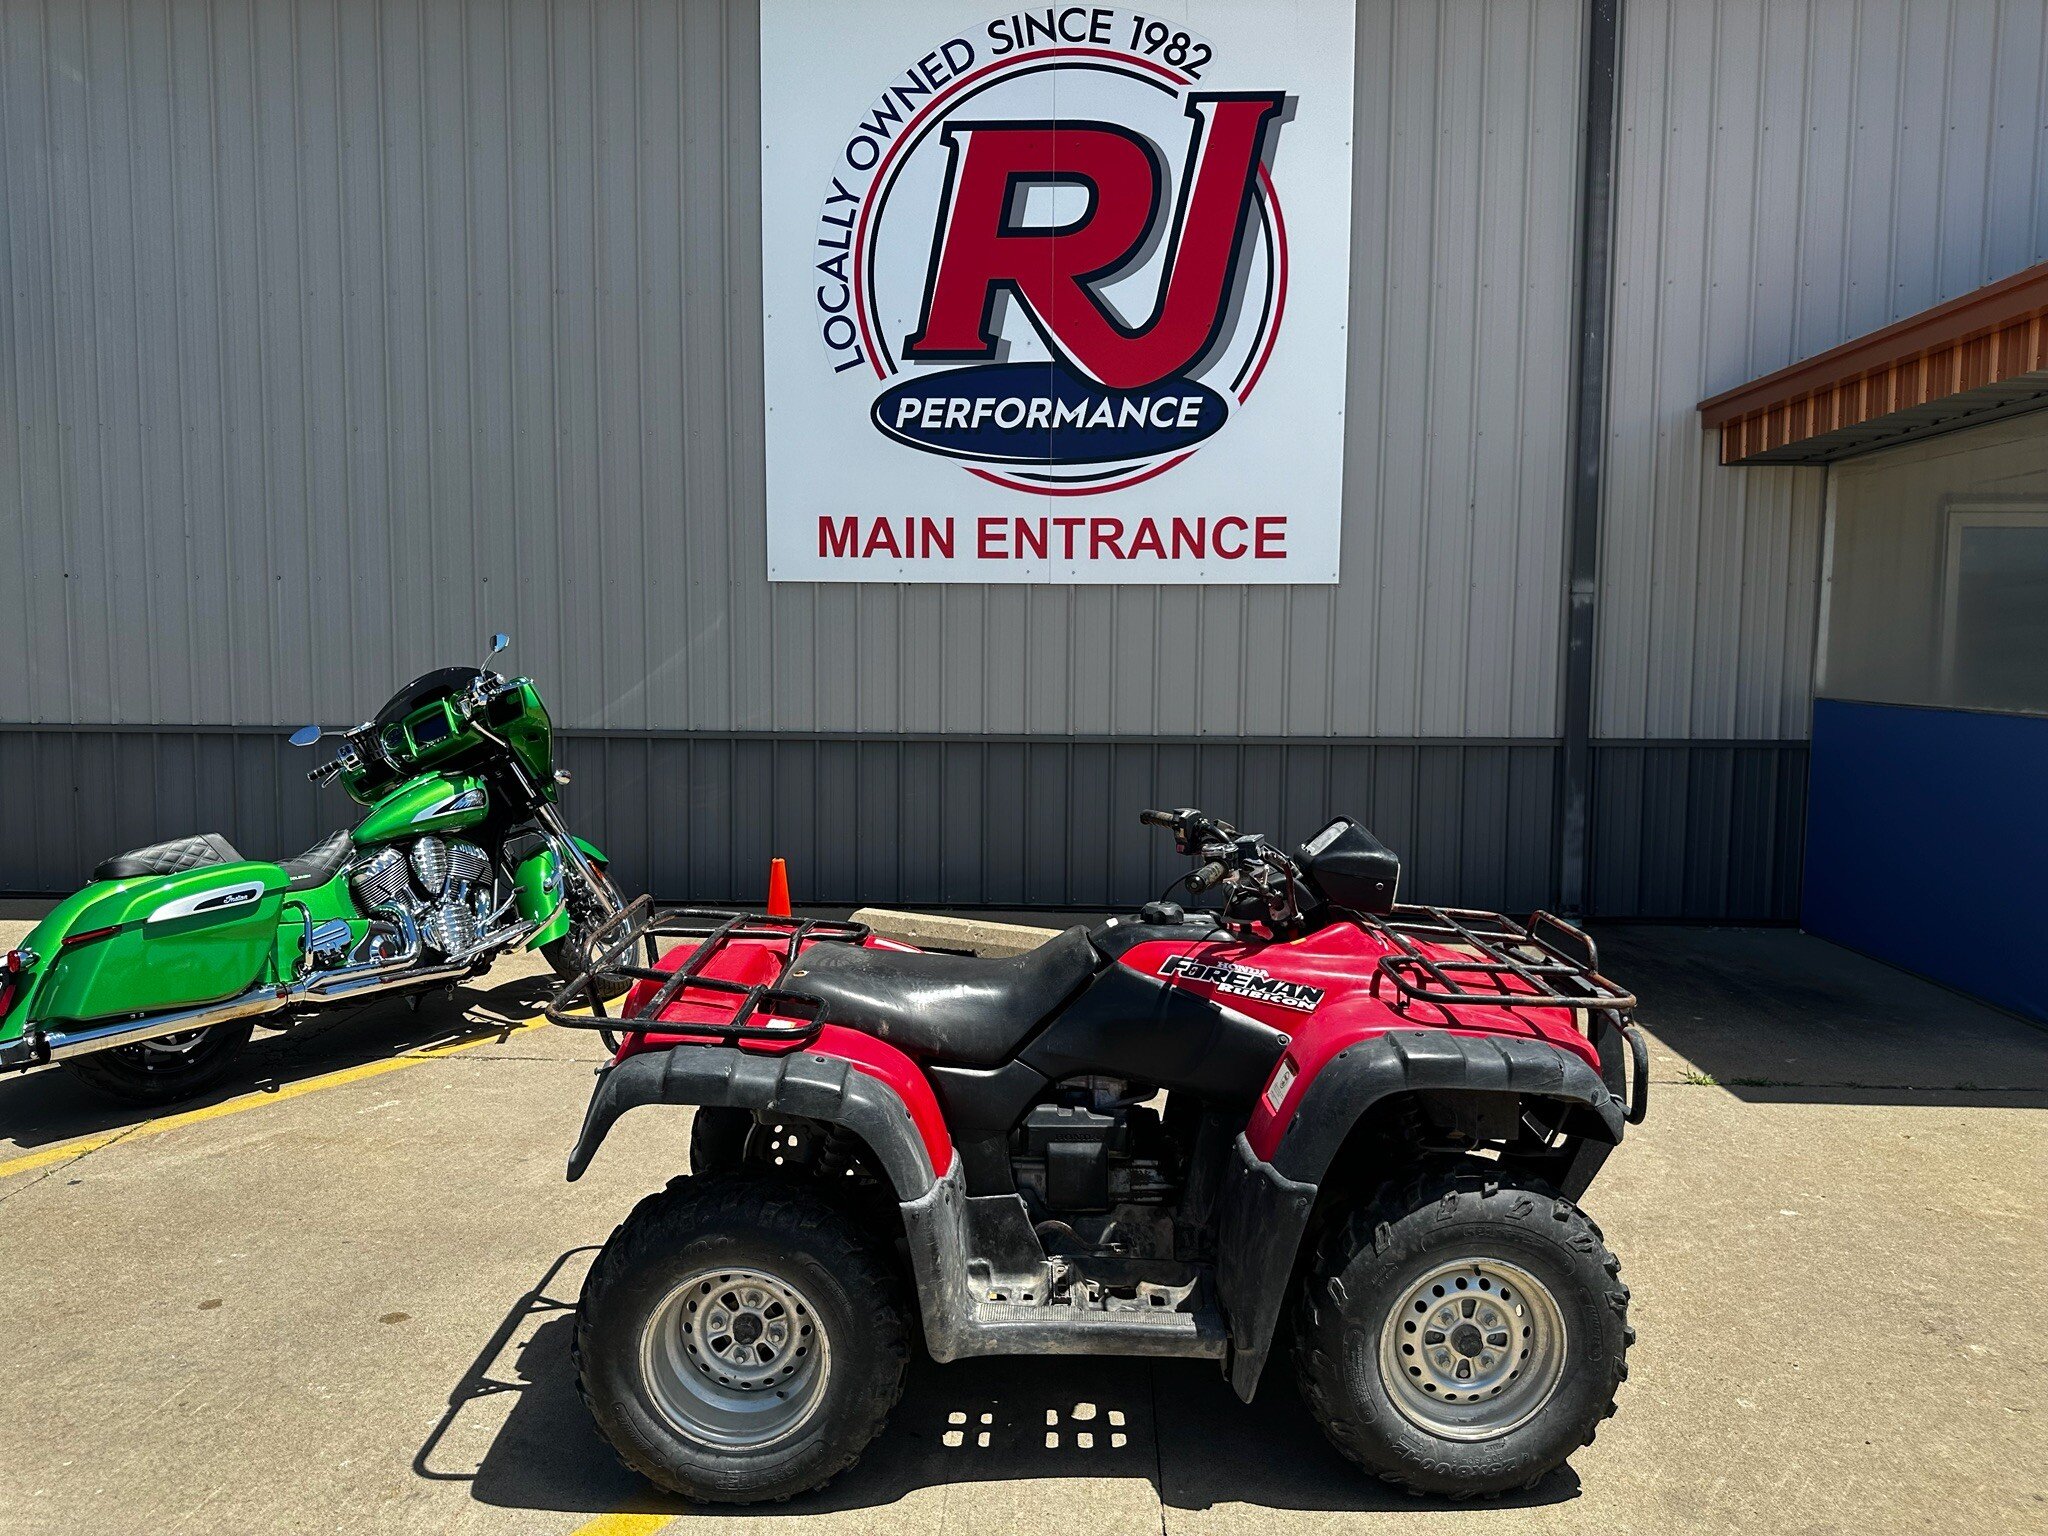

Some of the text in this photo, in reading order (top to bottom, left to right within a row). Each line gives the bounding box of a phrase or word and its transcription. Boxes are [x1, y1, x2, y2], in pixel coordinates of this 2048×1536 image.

[815, 7, 1213, 374] LOCALLY OWNED SINCE 1982
[902, 91, 1287, 390] RJ
[895, 396, 1204, 430] PERFORMANCE
[817, 516, 1288, 560] MAIN ENTRANCE
[1157, 954, 1326, 1004] FOREMAN
[1217, 961, 1270, 977] HONDA
[1216, 982, 1317, 1011] RUBICON
